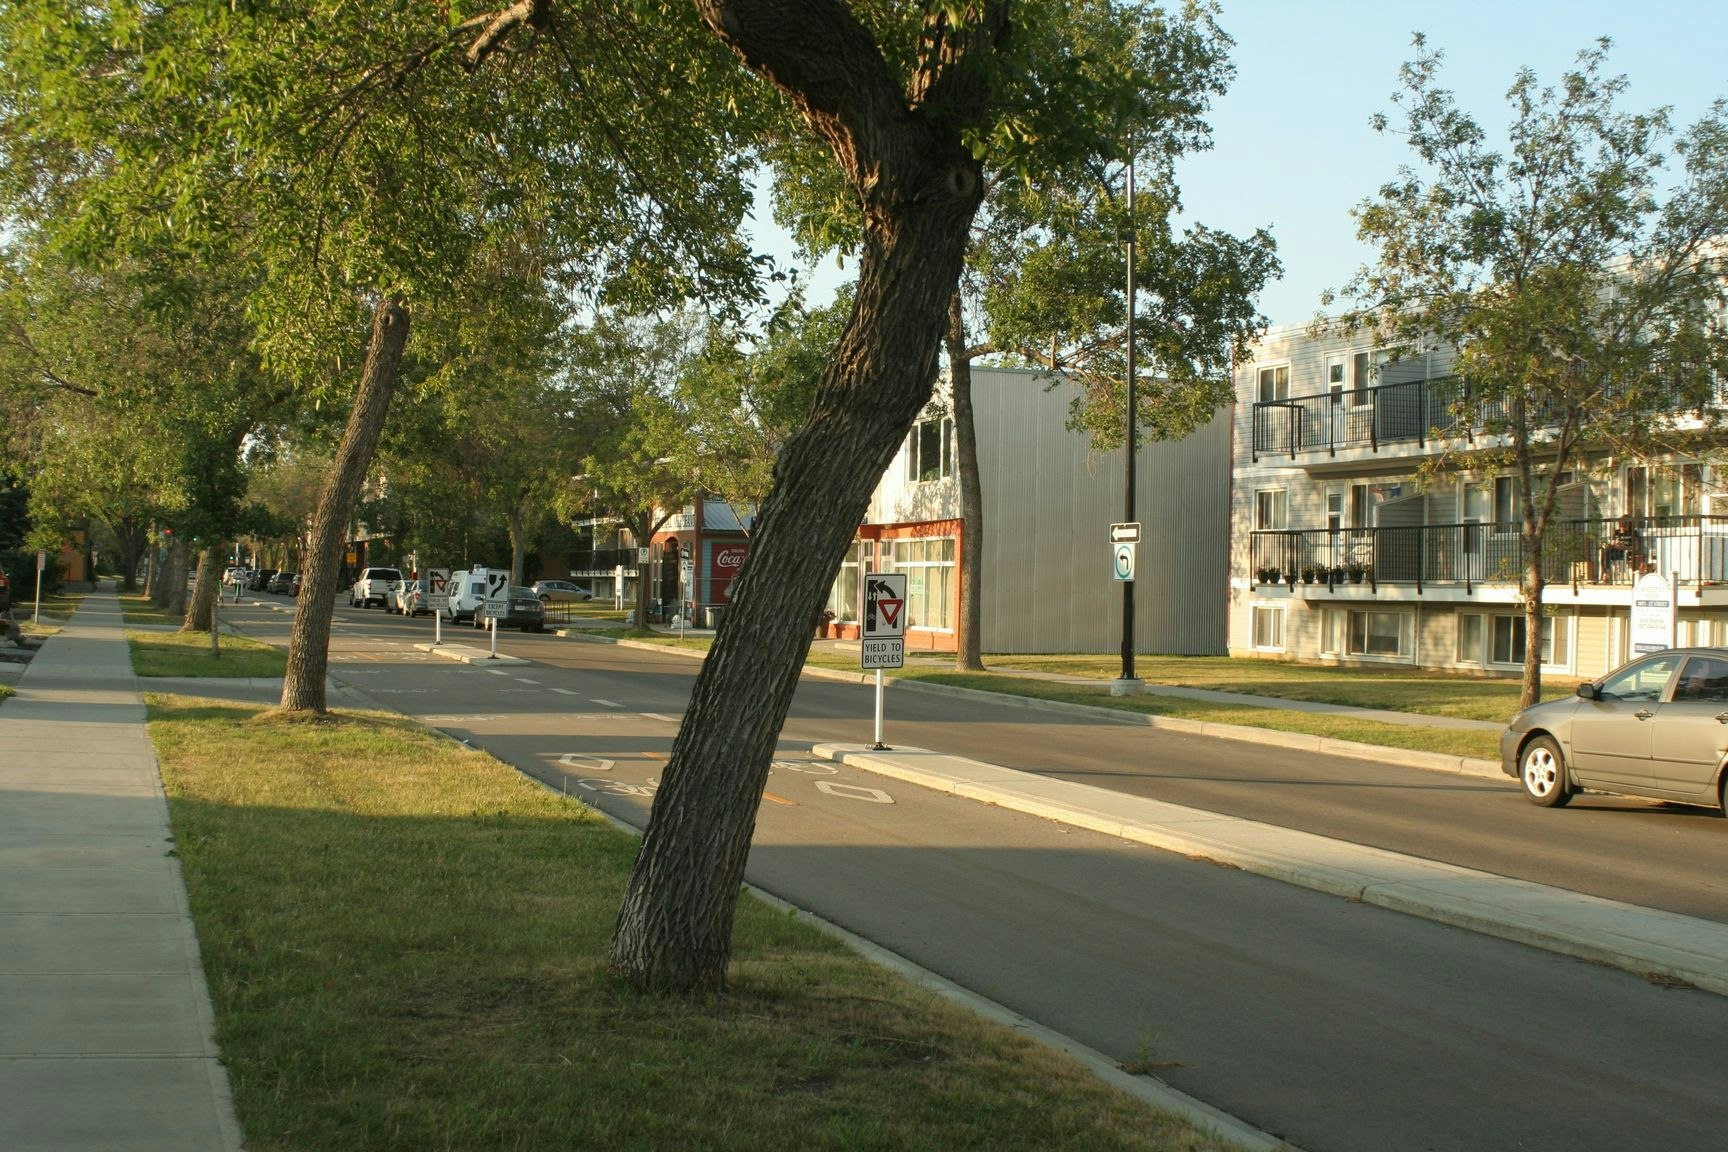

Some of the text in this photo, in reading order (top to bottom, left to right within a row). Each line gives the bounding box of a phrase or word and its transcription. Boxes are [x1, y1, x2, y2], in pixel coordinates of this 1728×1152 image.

[865, 643, 900, 652] YIELD TO
[865, 654, 900, 663] BICYCLES
